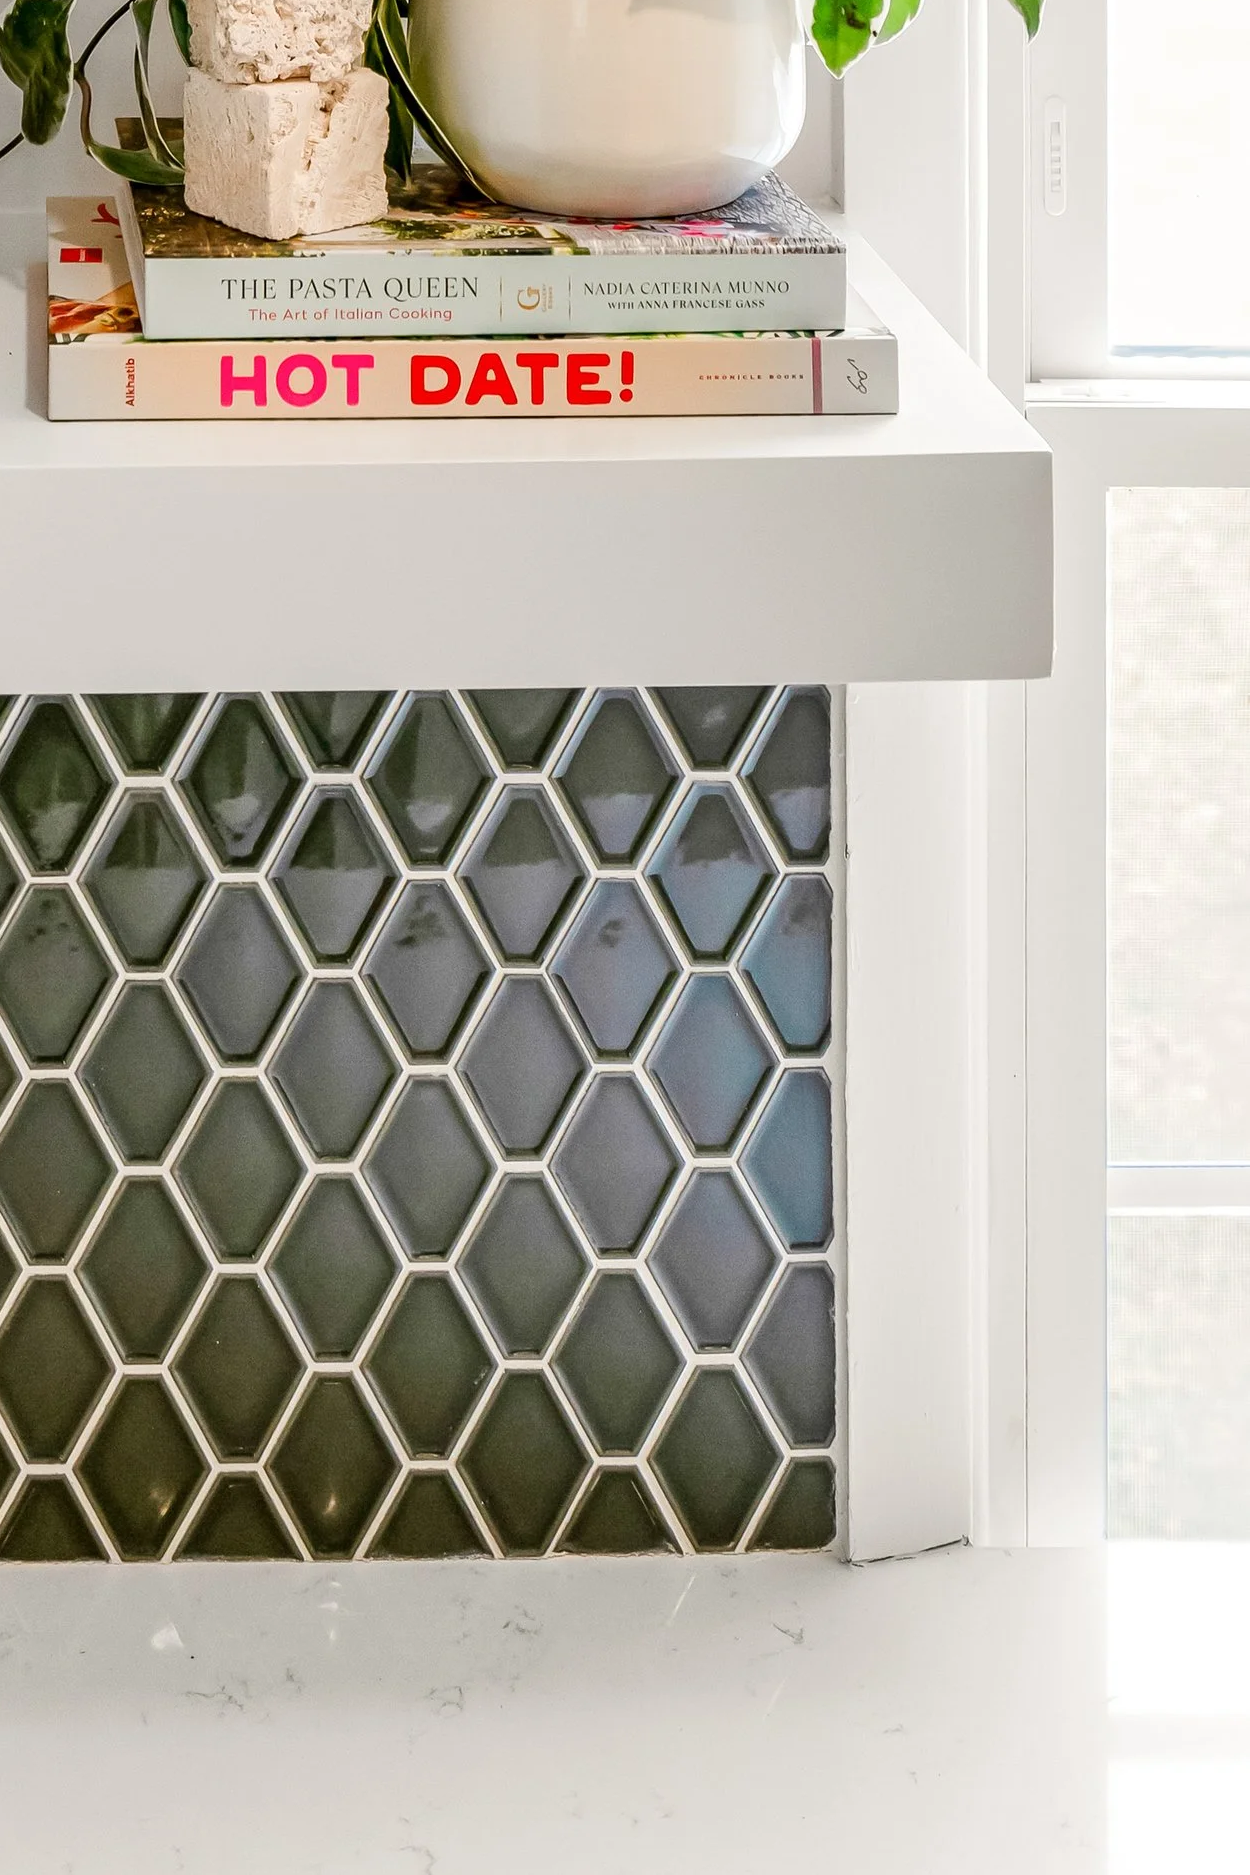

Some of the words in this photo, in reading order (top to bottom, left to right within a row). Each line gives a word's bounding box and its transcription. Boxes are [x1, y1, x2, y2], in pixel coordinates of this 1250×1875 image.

[220, 278, 277, 300] THE
[289, 277, 373, 300] PASTA
[383, 276, 478, 303] QUEEN
[583, 282, 635, 296] NADIA
[640, 281, 723, 295] CATERINA
[728, 280, 790, 294] MUNNO
[248, 308, 277, 321] The
[282, 308, 308, 321] Art
[313, 308, 329, 321] of
[335, 307, 383, 320] Italian
[388, 307, 453, 322] Cooking
[607, 301, 635, 311] WITH
[637, 300, 669, 310] ANNA
[672, 299, 732, 309] FRANCESE
[735, 298, 766, 309] GASS
[124, 357, 136, 407] Alkhatib
[220, 353, 375, 407] HOT
[410, 350, 635, 406] DATE!
